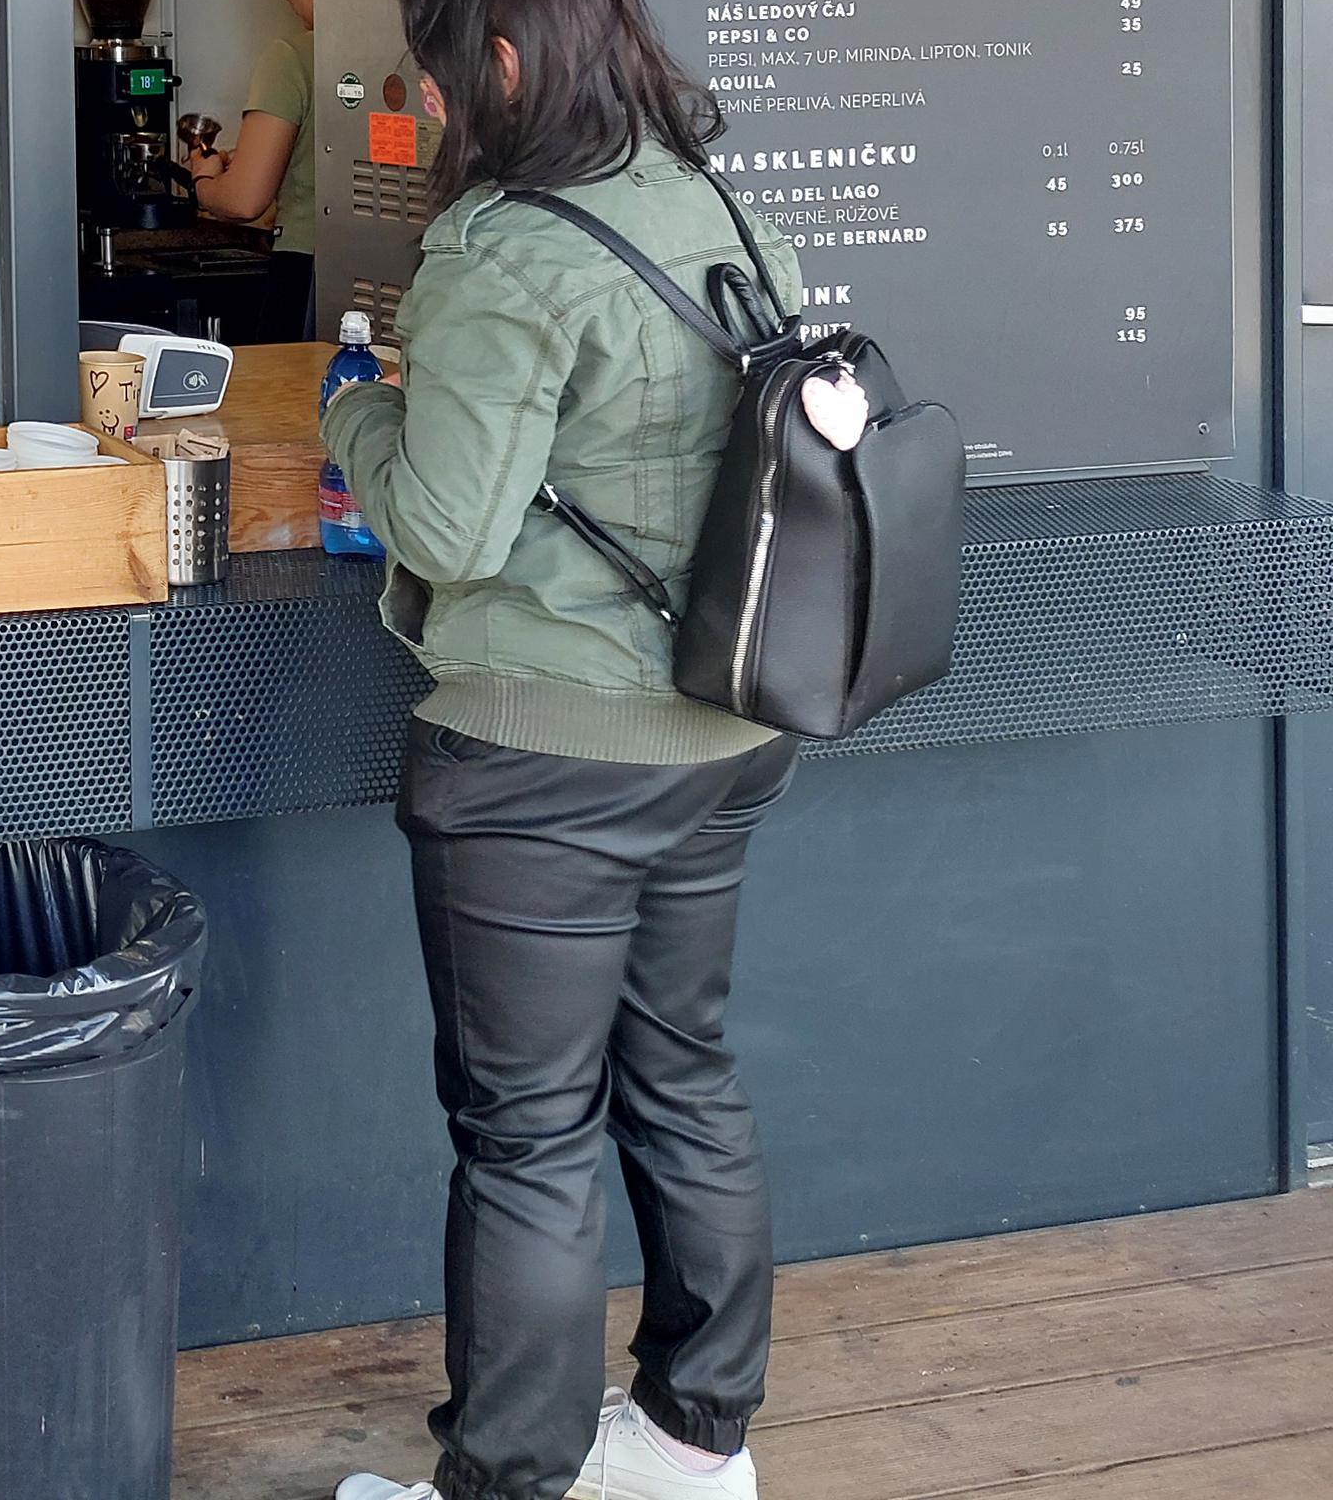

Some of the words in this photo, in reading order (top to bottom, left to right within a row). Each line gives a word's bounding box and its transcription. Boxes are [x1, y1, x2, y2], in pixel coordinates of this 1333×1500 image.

[708, 2, 743, 21] NÁŠ
[748, 1, 818, 19] LEDOVÝ
[822, 1, 854, 17] ČAJ
[1122, 18, 1141, 31] 35
[708, 29, 758, 44] PEPSI
[766, 29, 777, 42] &
[785, 28, 809, 41] CO
[804, 53, 812, 65] 7
[984, 43, 1031, 56] TONIK
[1122, 62, 1141, 75] 25
[709, 75, 775, 90] AQUILA
[718, 96, 762, 114] EMNĚ
[840, 89, 925, 108] NEPERLIVÁ
[710, 154, 745, 173] NA
[753, 143, 915, 170] SKLENIČKU
[1046, 177, 1066, 190] 45
[1112, 173, 1142, 188] 300
[762, 189, 785, 203] CA
[792, 188, 825, 201] DEL
[832, 185, 879, 199] LAGO
[836, 203, 899, 222] RŮŽOVÉ
[1047, 222, 1067, 236] 55
[1114, 218, 1143, 232] 375
[814, 232, 836, 246] DE
[843, 228, 927, 245] BERNARD
[1125, 307, 1145, 320] 95
[1117, 329, 1145, 342] 115
